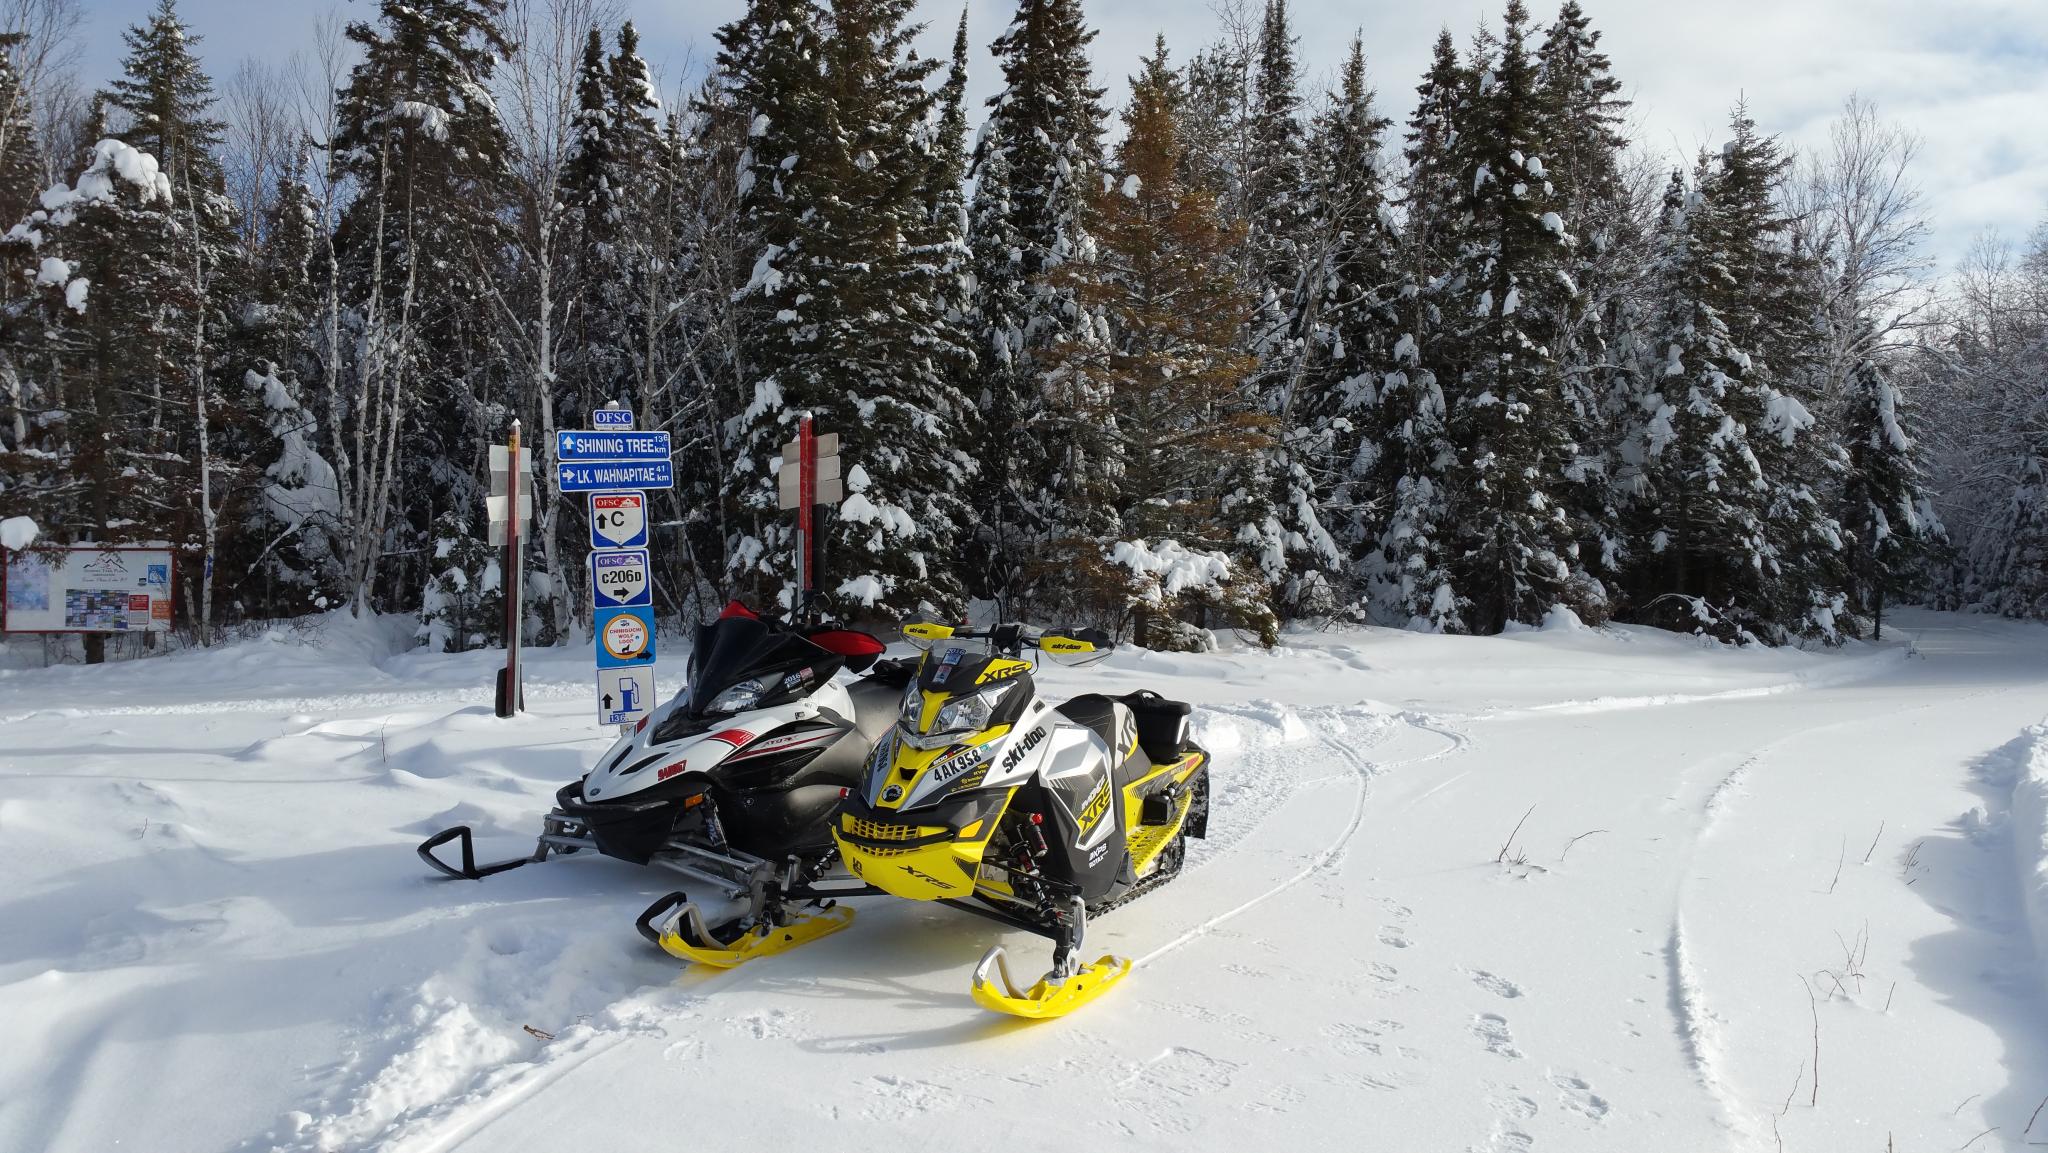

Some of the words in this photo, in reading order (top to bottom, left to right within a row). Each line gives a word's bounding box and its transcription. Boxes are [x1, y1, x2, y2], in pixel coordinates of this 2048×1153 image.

[596, 412, 631, 423] OFSC
[576, 439, 624, 454] SHINING
[626, 438, 655, 453] TREE
[654, 434, 668, 443] 136
[654, 445, 667, 453] km
[577, 469, 593, 484] LK.
[594, 467, 655, 483] WAHNAPITAE
[656, 465, 665, 473] 41
[657, 474, 669, 482] km
[597, 499, 620, 507] OFSC
[610, 510, 625, 527] C
[600, 557, 623, 566] OFSC
[983, 661, 1027, 682] XRS
[933, 749, 981, 782] 4AK958
